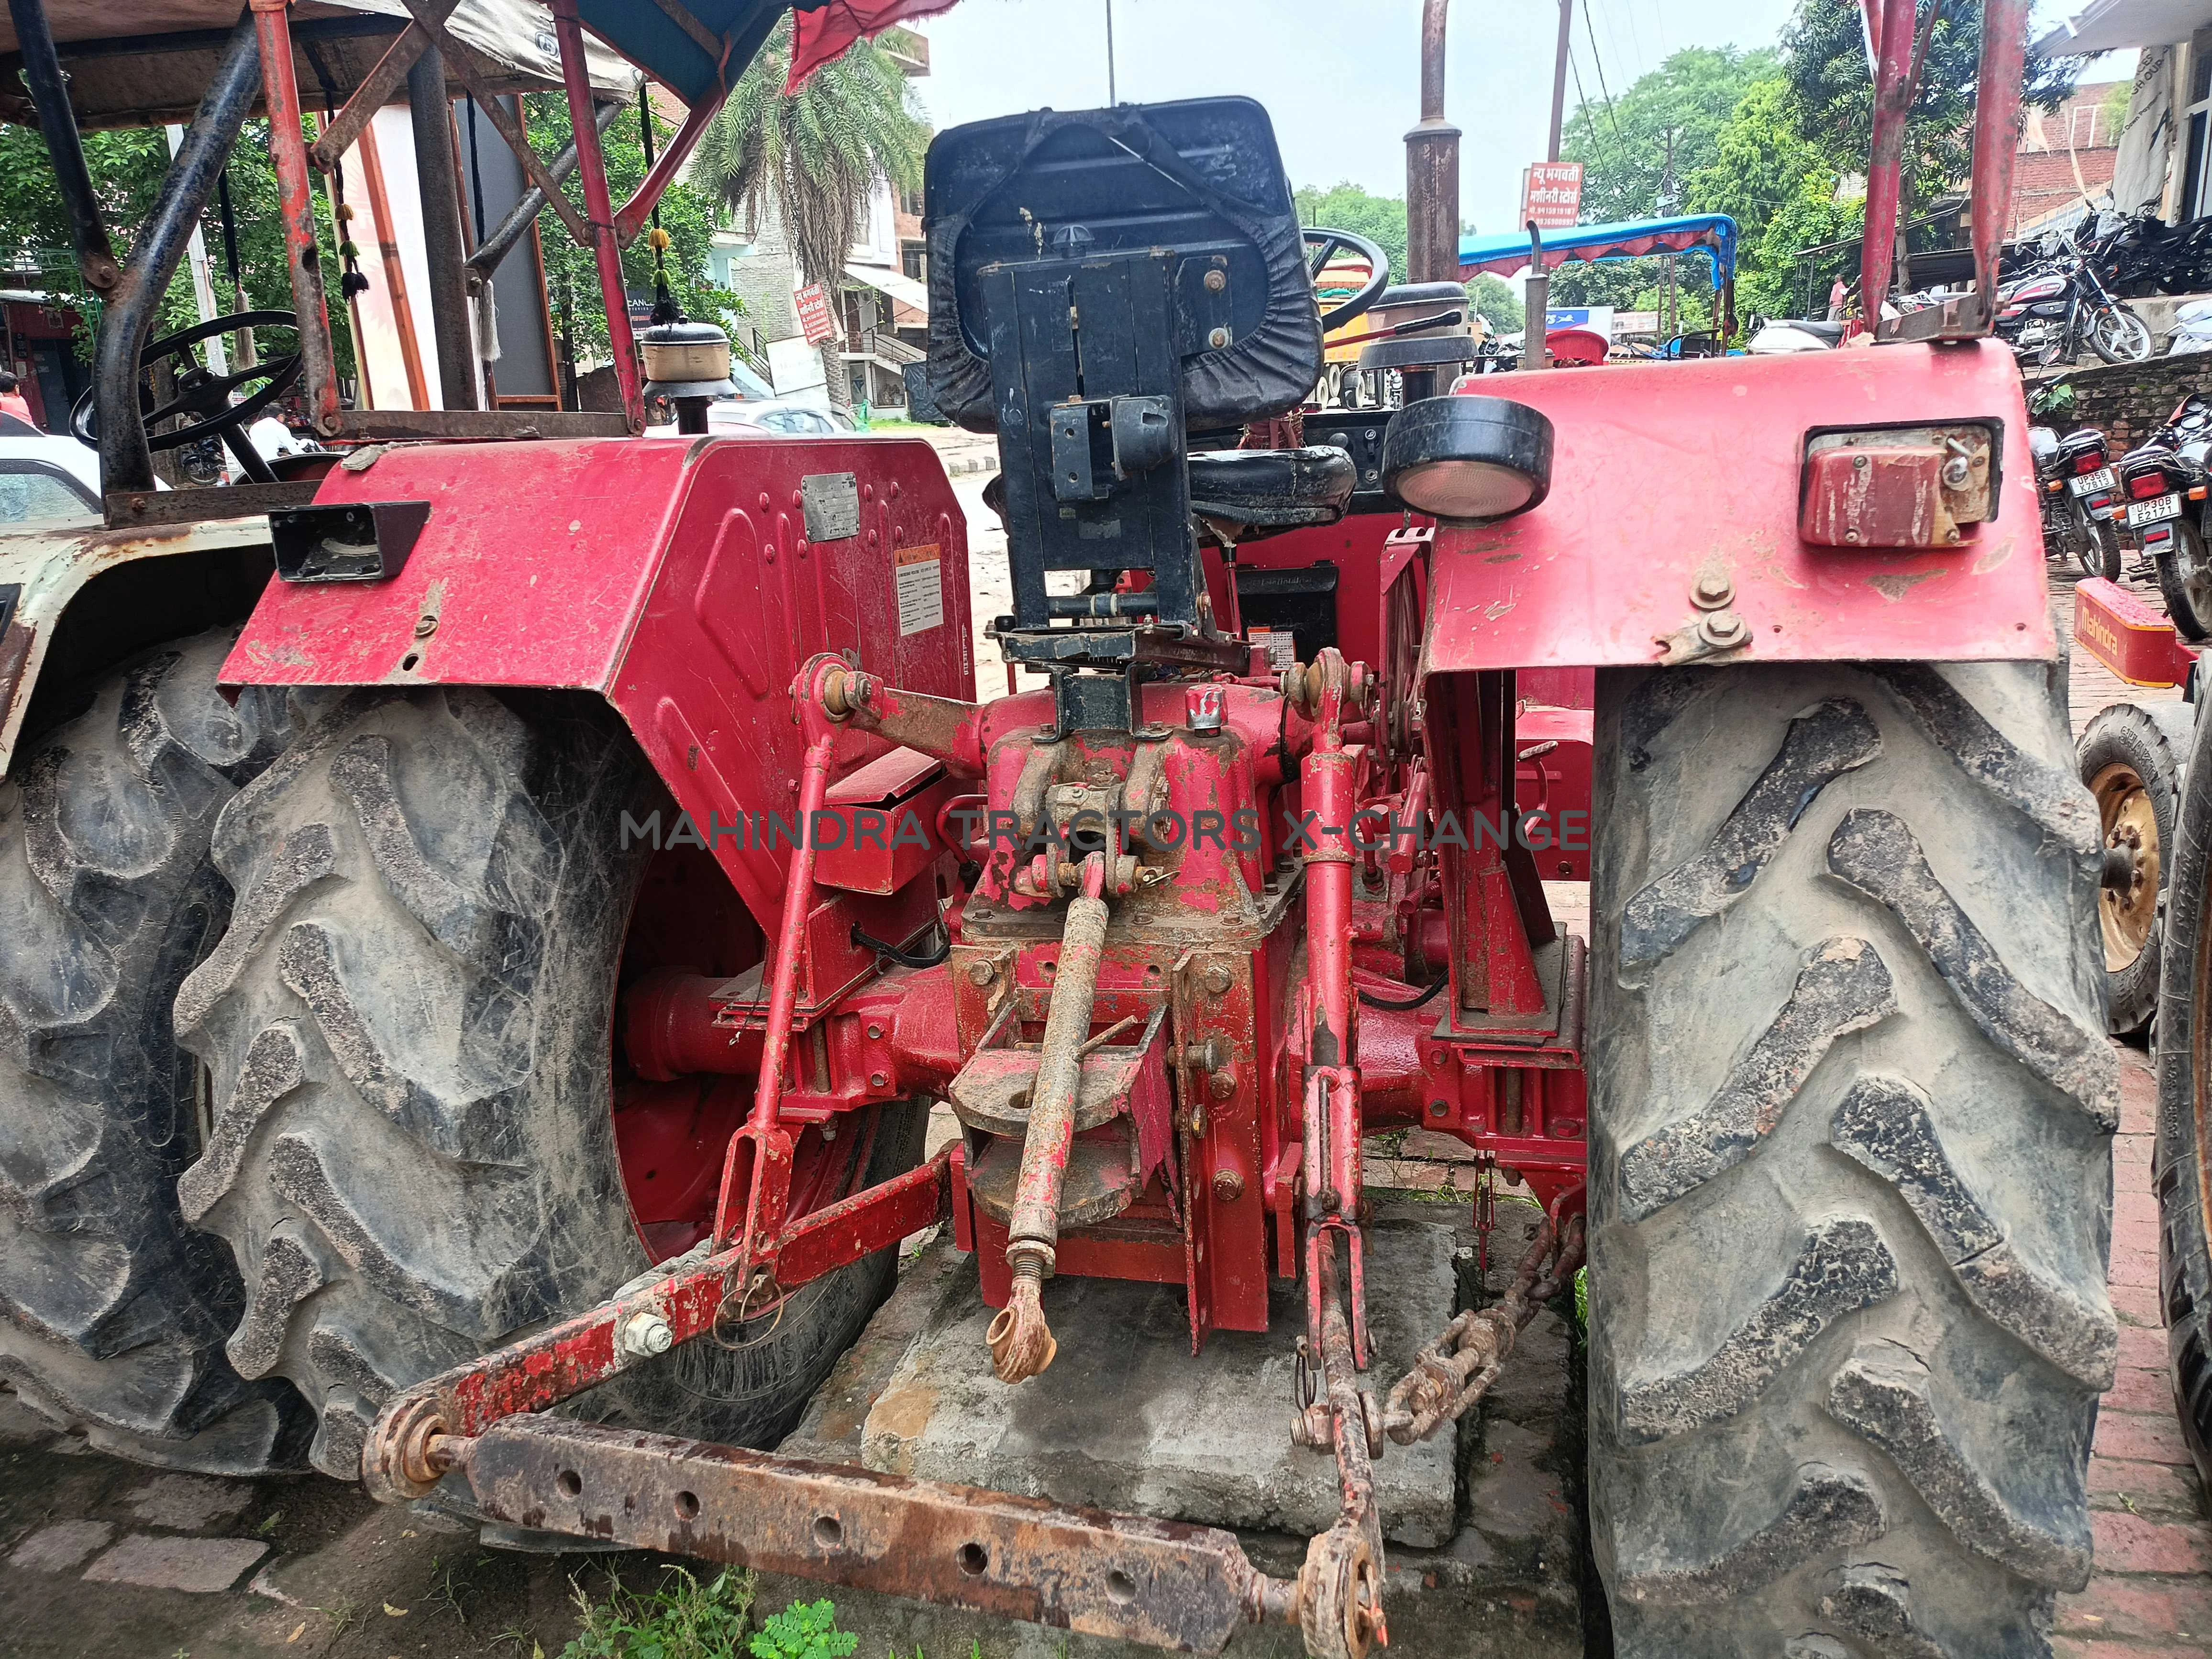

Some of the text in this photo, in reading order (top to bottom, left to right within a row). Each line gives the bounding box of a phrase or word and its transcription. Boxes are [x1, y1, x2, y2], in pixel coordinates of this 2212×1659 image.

[1533, 166, 1579, 185] न्यू भगवती
[1530, 187, 1578, 204] मशीनरी स्टोर्स
[2077, 470, 2107, 485] UP35B
[2080, 478, 2109, 492] K7813
[2137, 497, 2172, 512] UP30B
[2138, 506, 2172, 522] E2171
[2081, 605, 2118, 656] Mahindra
